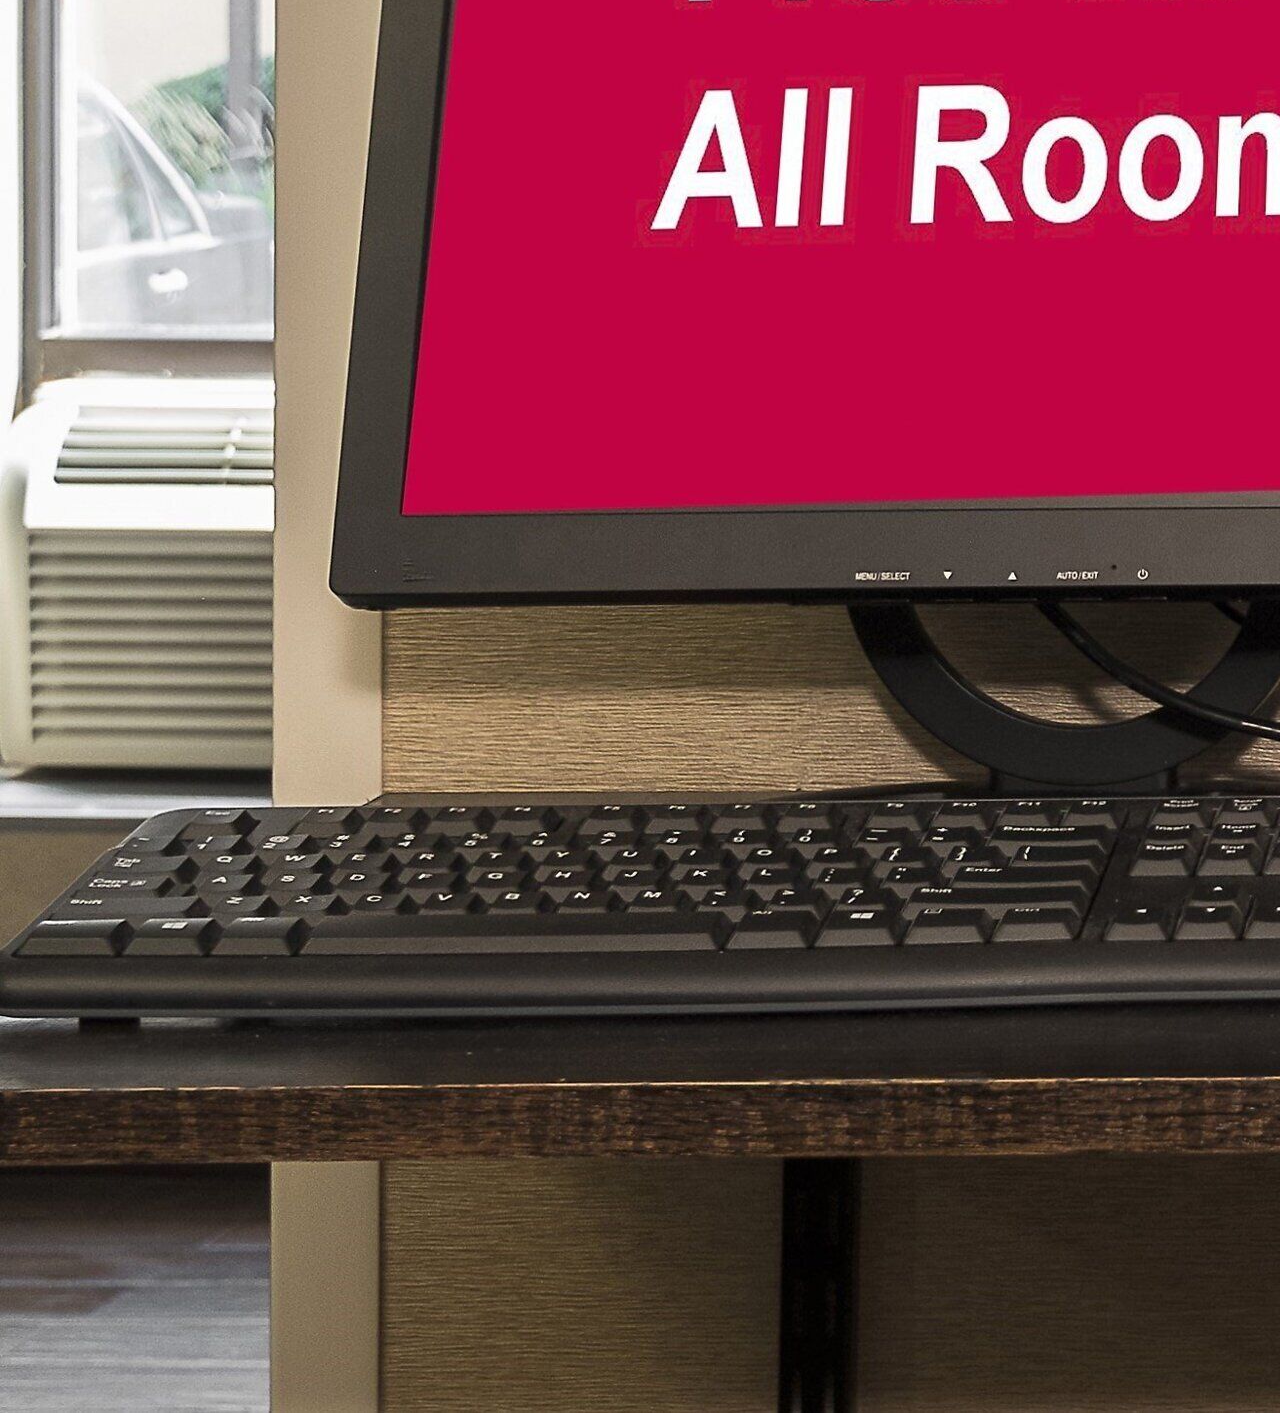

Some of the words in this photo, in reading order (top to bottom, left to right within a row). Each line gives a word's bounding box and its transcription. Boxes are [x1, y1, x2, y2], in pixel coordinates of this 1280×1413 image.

[651, 87, 853, 230] All
[216, 855, 233, 863] Q
[281, 875, 295, 883] S
[644, 891, 662, 899] M
